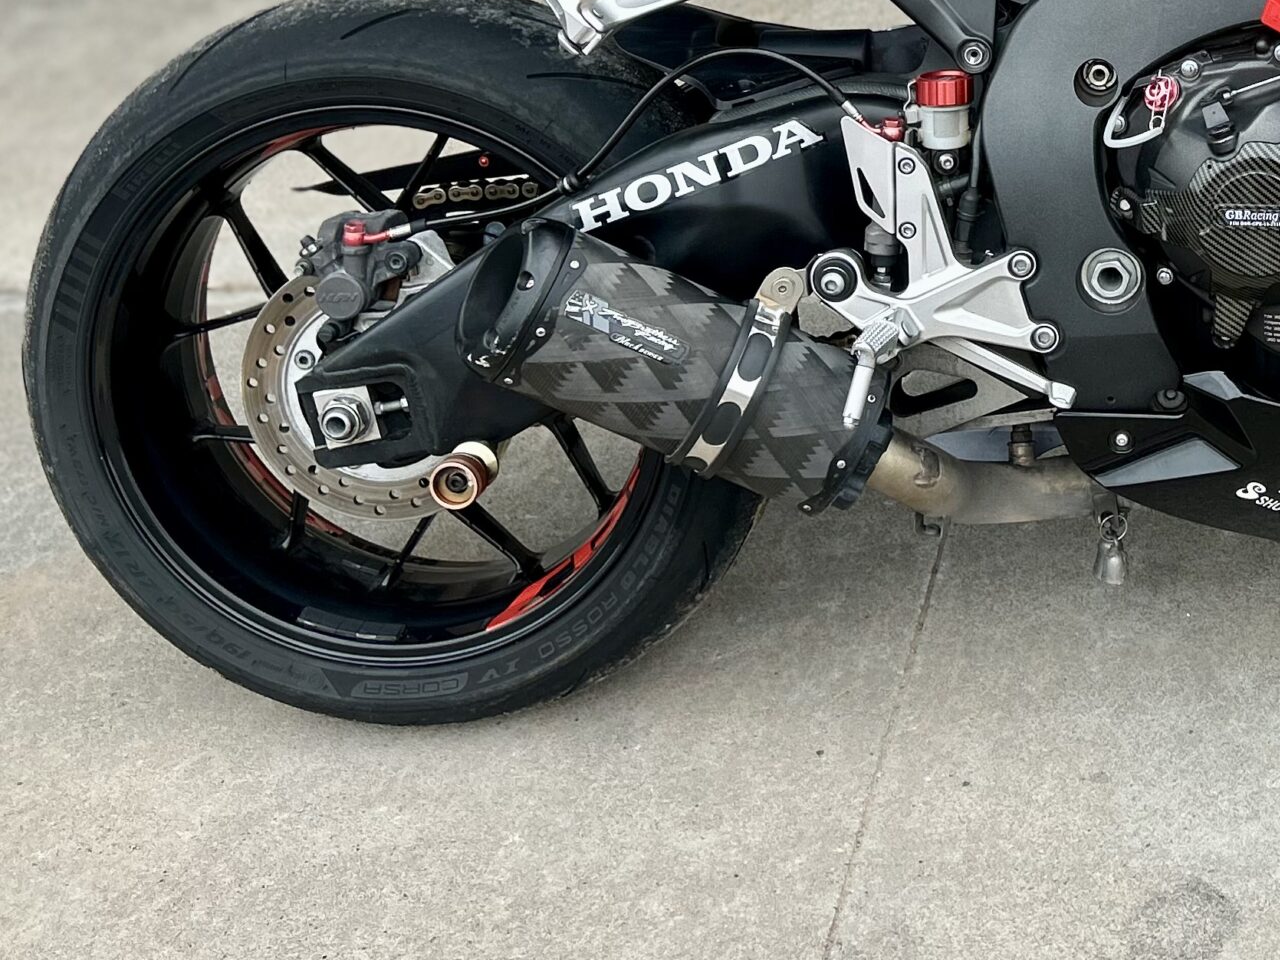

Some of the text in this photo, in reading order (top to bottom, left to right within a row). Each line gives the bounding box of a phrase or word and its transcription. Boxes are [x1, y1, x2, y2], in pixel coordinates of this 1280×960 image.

[571, 119, 824, 234] HONDA
[537, 591, 619, 660] ROSSO
[360, 677, 462, 697] CORSA
